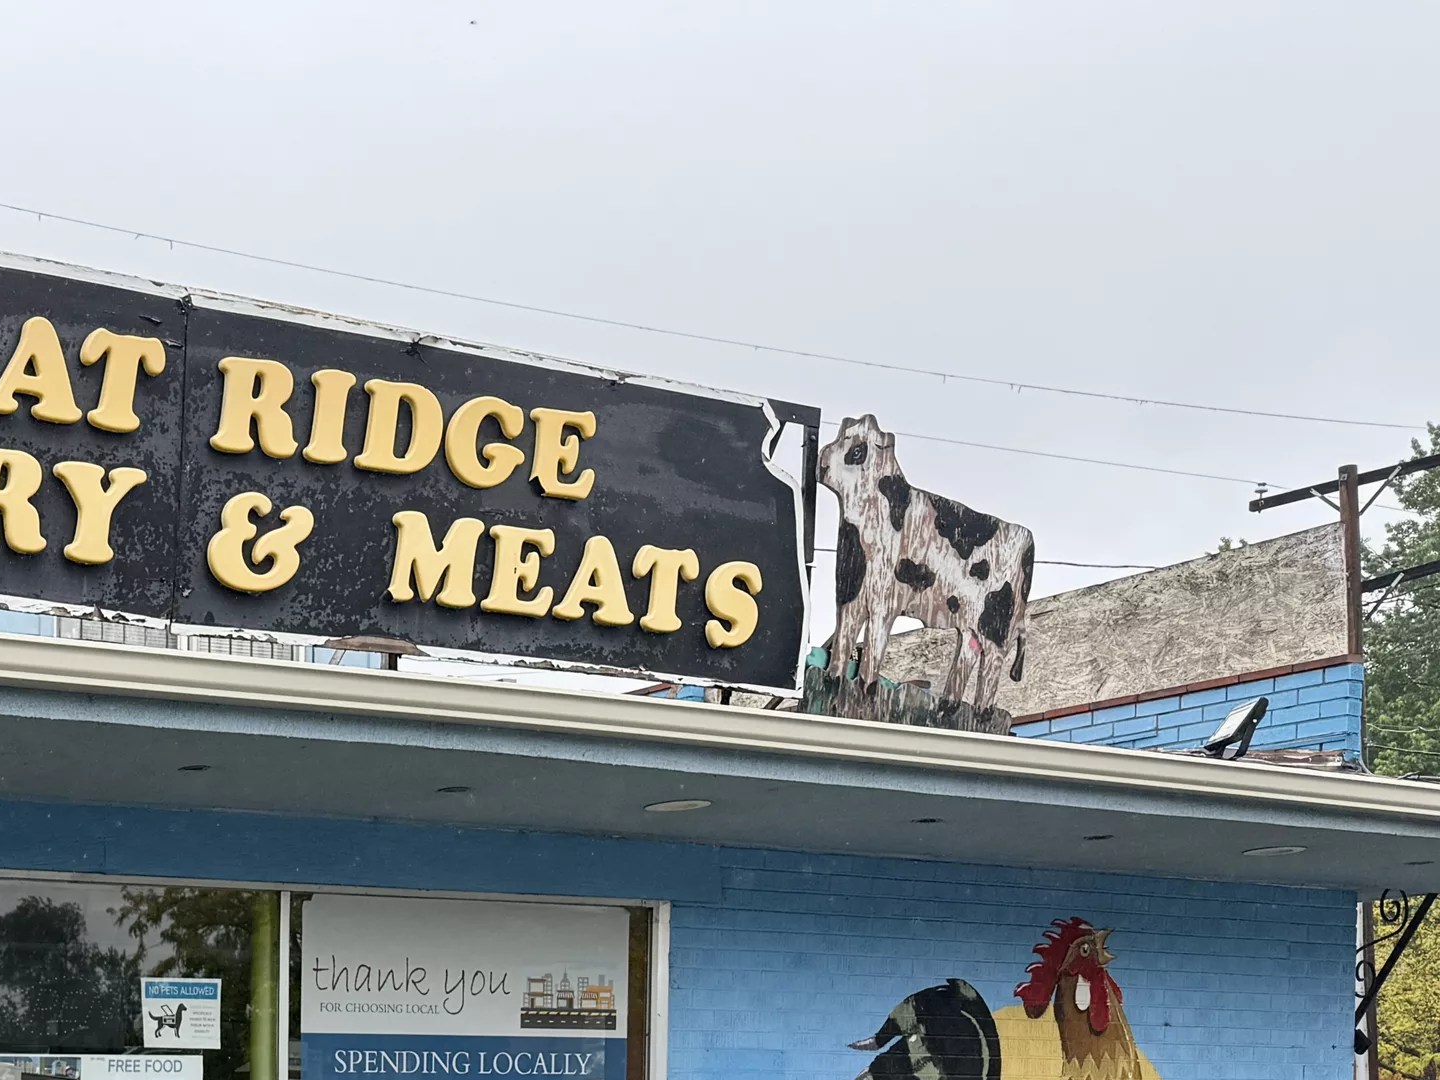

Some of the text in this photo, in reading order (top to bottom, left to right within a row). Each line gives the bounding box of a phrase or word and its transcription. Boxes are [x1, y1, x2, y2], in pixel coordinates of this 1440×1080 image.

[213, 356, 599, 502] RIDGE
[206, 491, 315, 594] &
[390, 510, 764, 649] MEATS
[148, 985, 215, 996] NO PETS ALLOWED
[312, 955, 512, 1016] thank you
[320, 1002, 439, 1014] FOR CHOOSING LOCAL
[108, 1059, 141, 1073] FREE
[145, 1059, 182, 1073] FOOD
[335, 1050, 594, 1075] SPENDING LOCALLY
